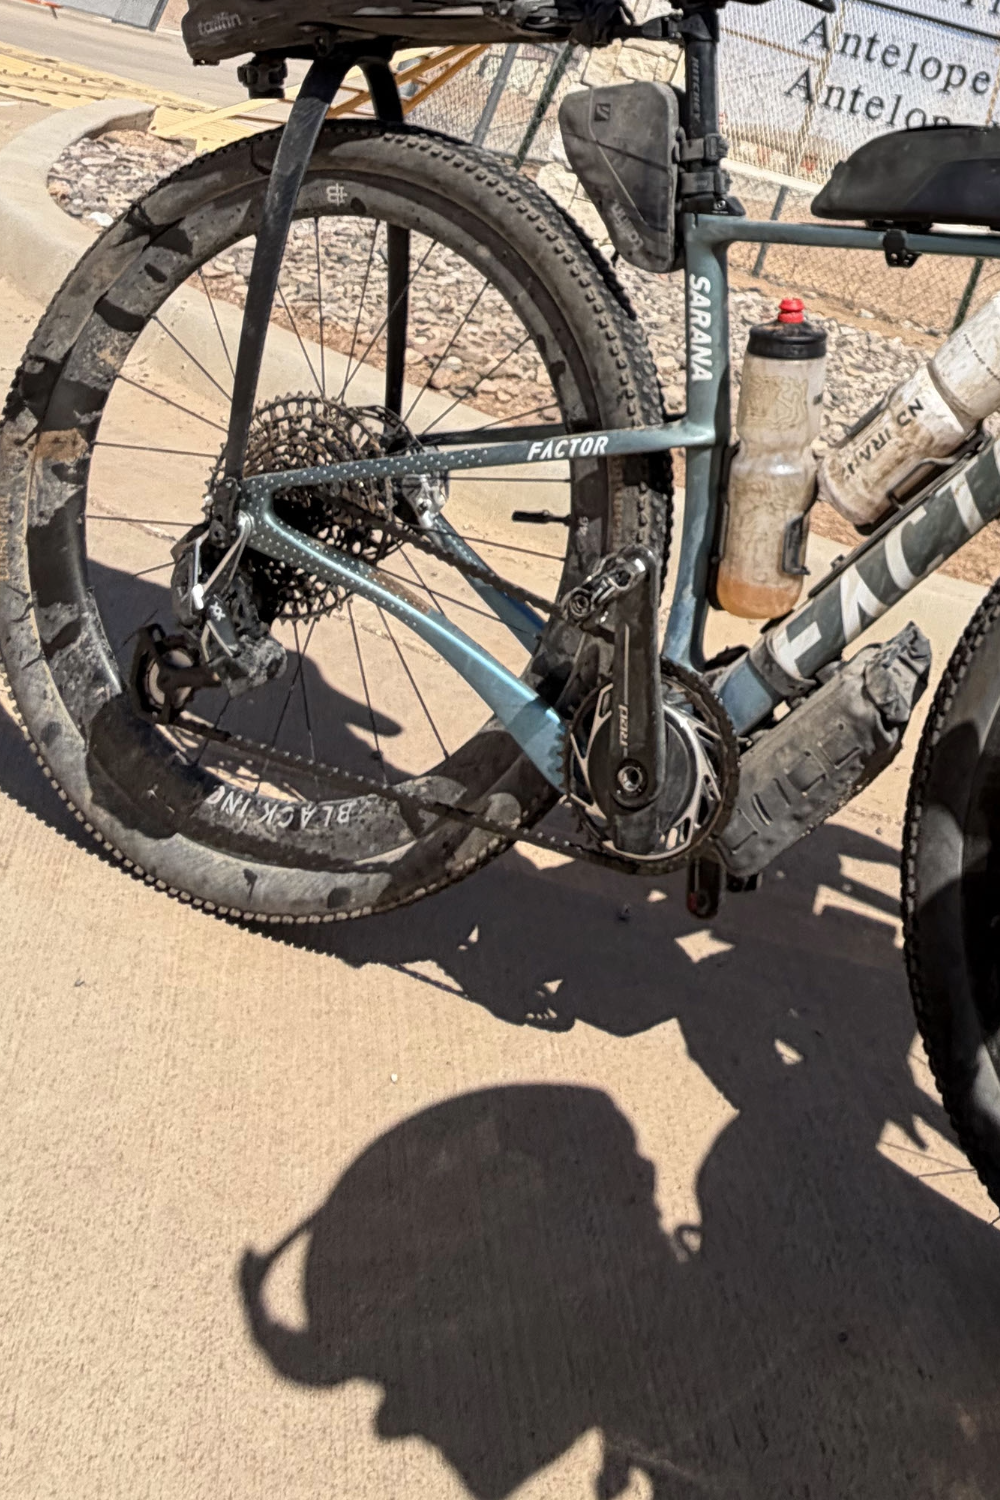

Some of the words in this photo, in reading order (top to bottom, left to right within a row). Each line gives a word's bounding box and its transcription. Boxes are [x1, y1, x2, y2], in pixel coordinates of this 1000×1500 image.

[800, 15, 993, 97] Antelope
[689, 273, 714, 381] SARANA
[527, 436, 609, 461] FACTOR
[255, 801, 354, 830] BLACK
